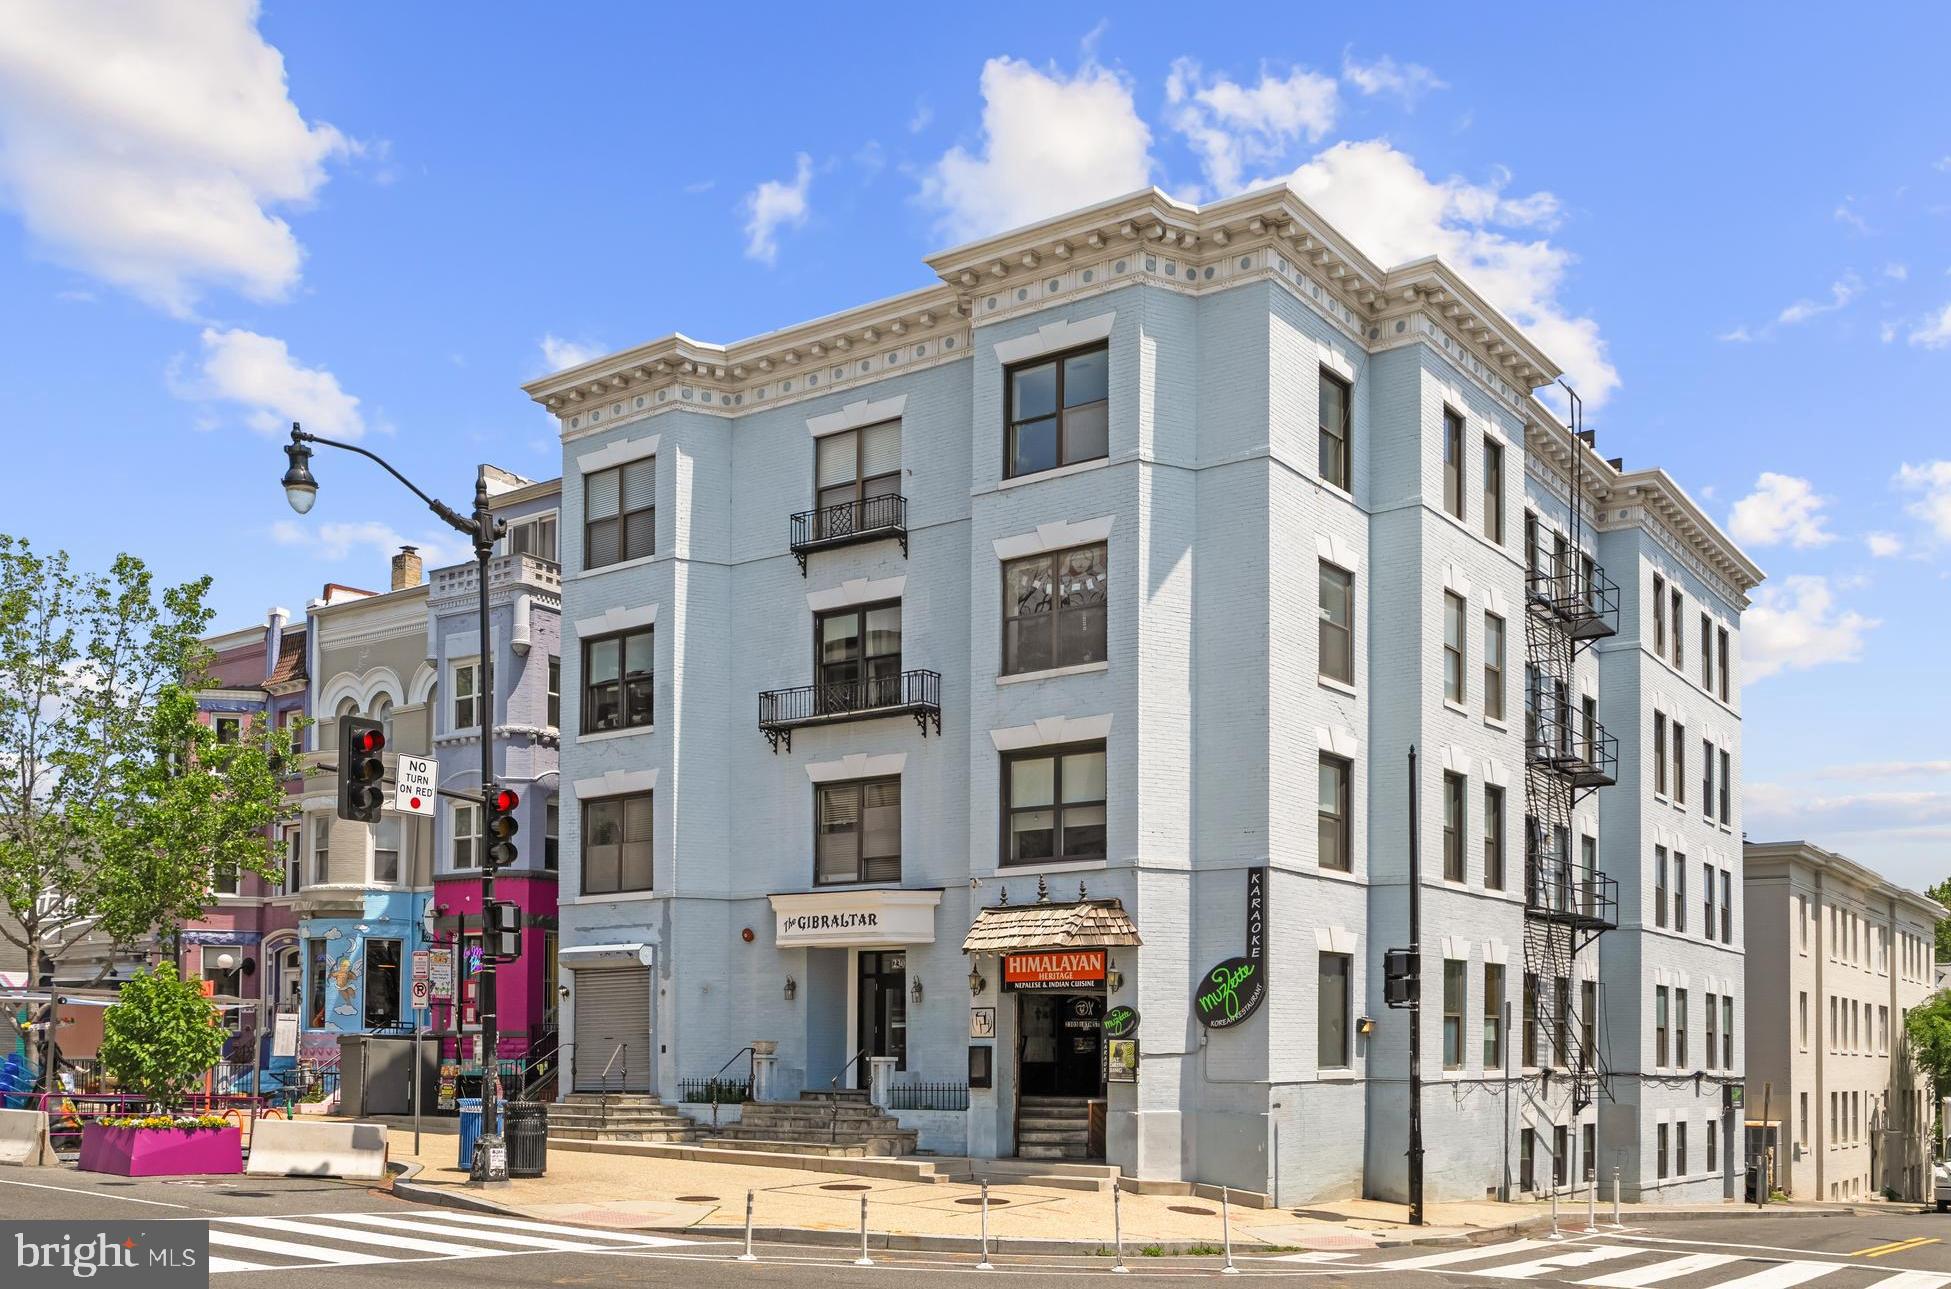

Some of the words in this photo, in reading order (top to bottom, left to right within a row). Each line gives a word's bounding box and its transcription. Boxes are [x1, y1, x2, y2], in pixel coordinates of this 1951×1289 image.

[409, 760, 427, 773] NO
[406, 773, 429, 785] TURN
[400, 783, 412, 794] ON
[416, 786, 433, 797] RED
[1250, 873, 1262, 958] KARAOKE
[783, 916, 797, 933] The
[797, 913, 878, 931] GIBRALTAR
[1009, 954, 1101, 973] HIMALAYAN
[1038, 971, 1074, 980] HERITAGE
[1014, 981, 1041, 989] NEPALESE
[1048, 980, 1070, 988] INDIAN
[1070, 979, 1095, 988] CUISINE
[1210, 1017, 1236, 1028] KOREAN
[1235, 982, 1263, 1021] RESTAURANT
